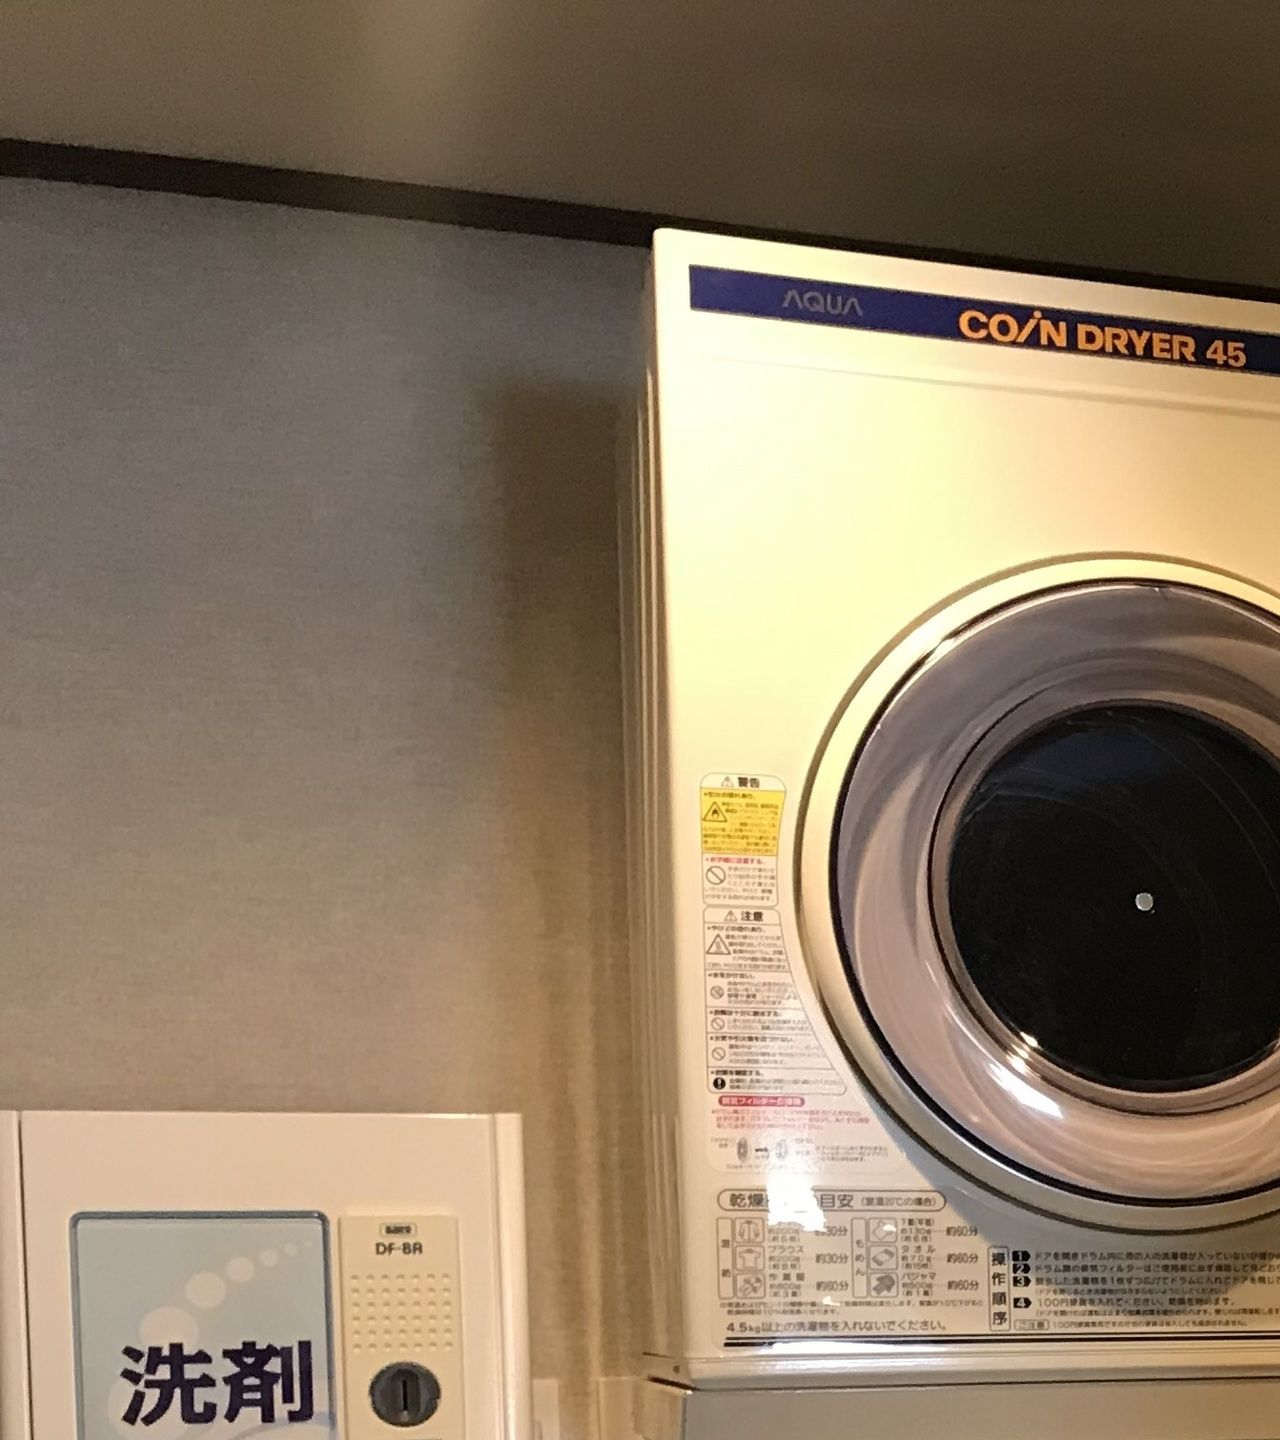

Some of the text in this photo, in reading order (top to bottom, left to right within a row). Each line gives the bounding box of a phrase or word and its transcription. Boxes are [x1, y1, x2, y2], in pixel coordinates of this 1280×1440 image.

[782, 289, 864, 317] AQUA
[1077, 324, 1196, 363] DRYER
[1205, 339, 1247, 368] 45
[740, 910, 764, 923] 注意
[728, 1193, 855, 1208] 乾燥目安
[119, 1339, 315, 1427] 洗剤
